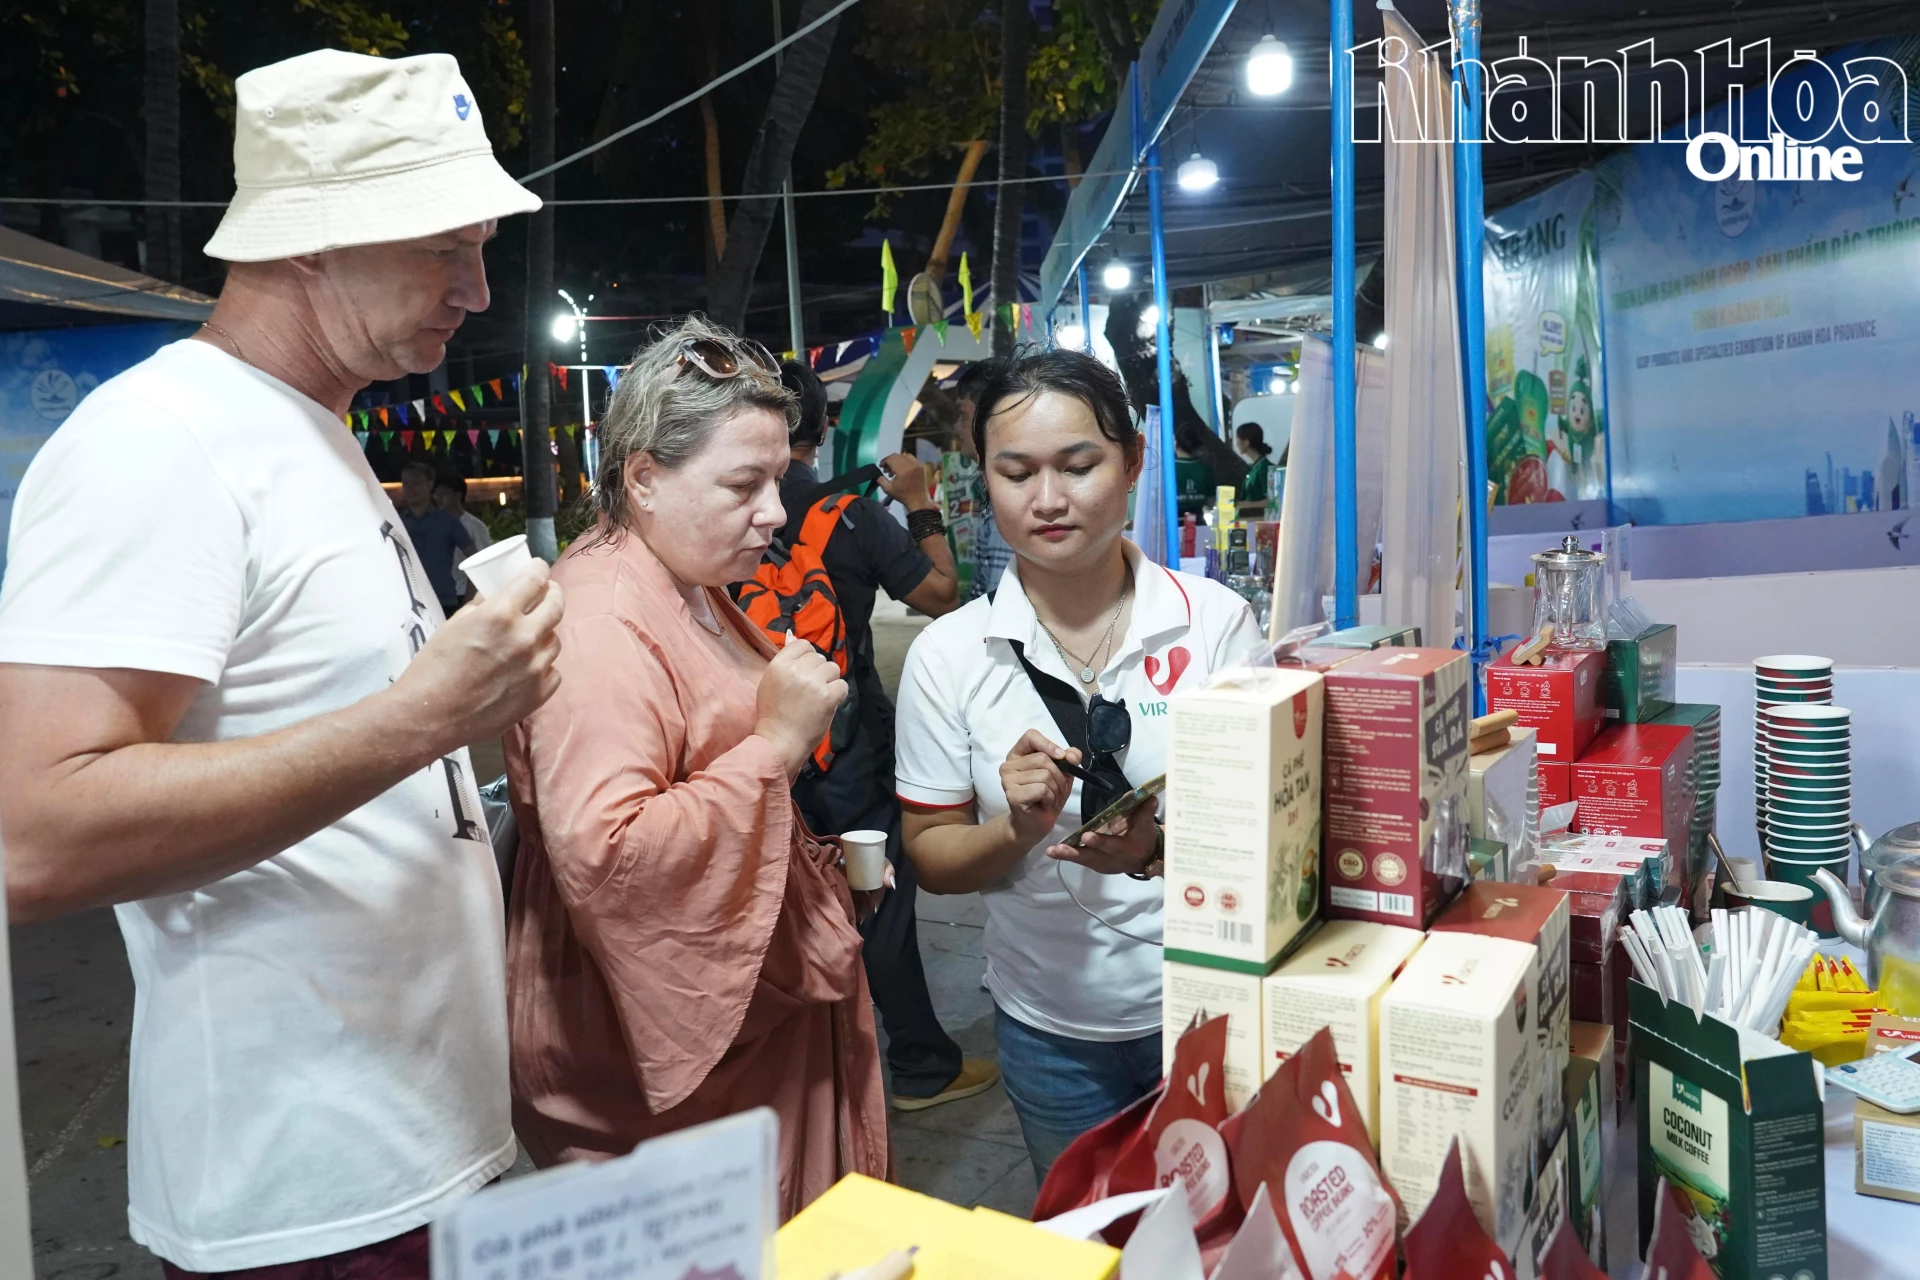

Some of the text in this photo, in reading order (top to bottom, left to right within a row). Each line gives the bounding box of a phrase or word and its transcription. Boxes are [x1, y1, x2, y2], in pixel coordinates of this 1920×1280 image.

[1139, 702, 1168, 716] VIR
[1663, 1107, 1713, 1152] COCONUT
[1666, 1129, 1711, 1166] MILK COFFEE
[1299, 1165, 1347, 1222] ROASTED
